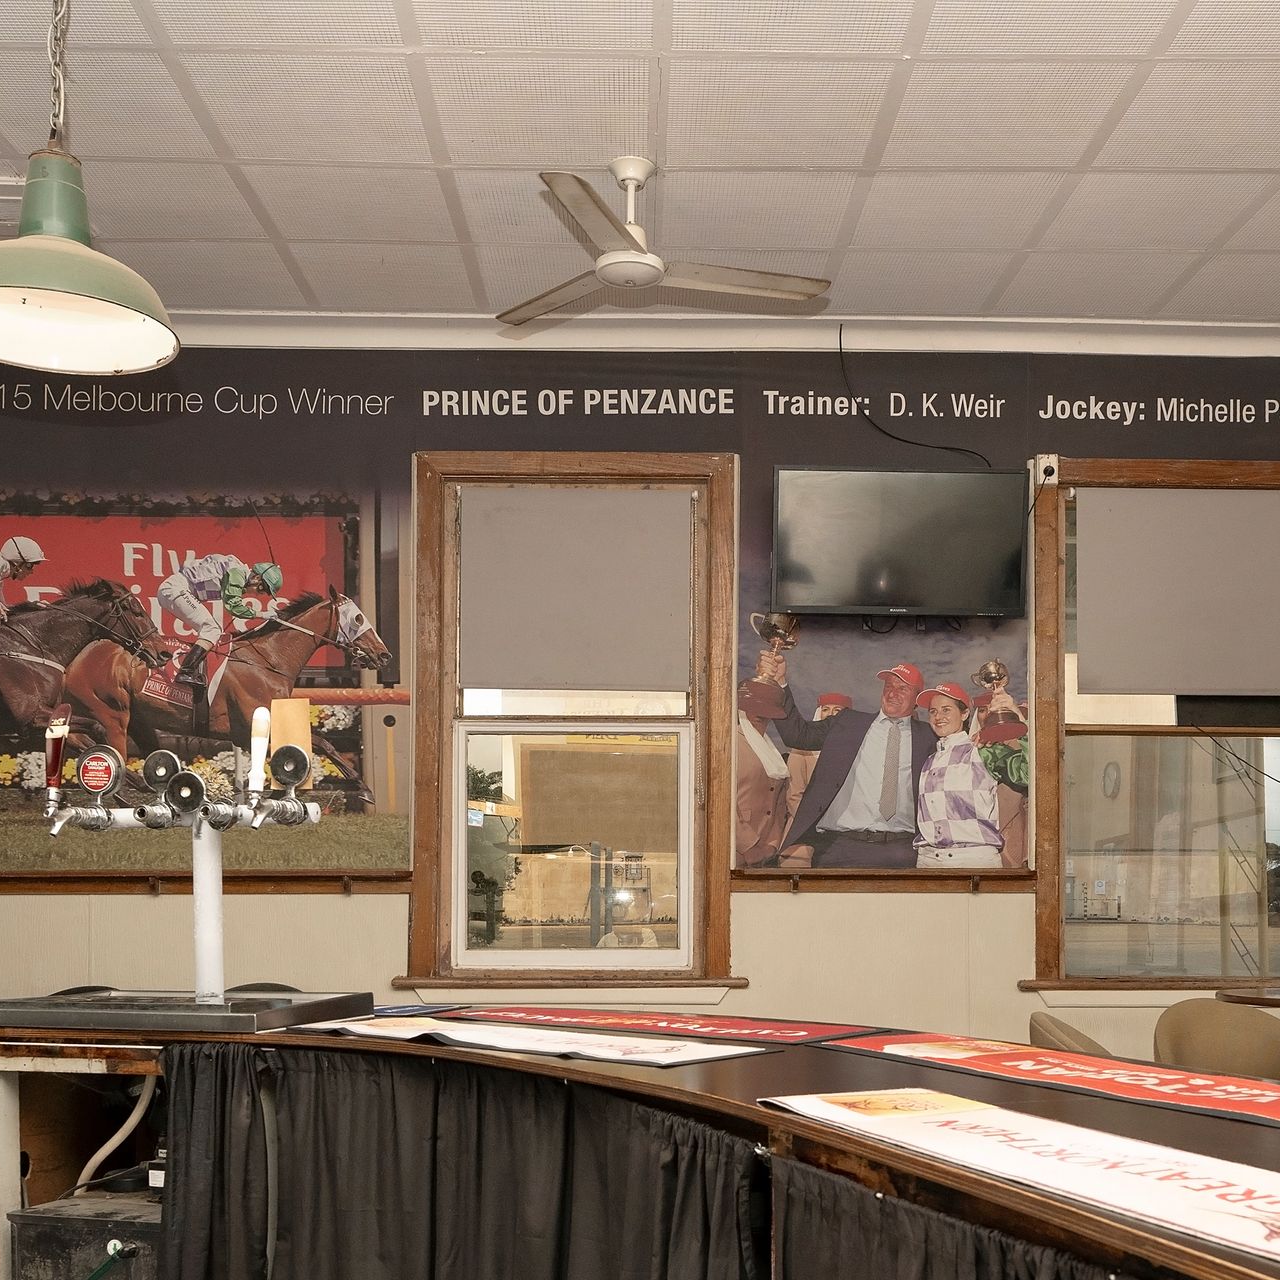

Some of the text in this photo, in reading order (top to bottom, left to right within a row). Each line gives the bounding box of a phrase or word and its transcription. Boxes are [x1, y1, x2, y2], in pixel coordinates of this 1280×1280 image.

[44, 383, 203, 413] Melbourne
[214, 386, 278, 420] Cup
[287, 387, 395, 415] Winner
[422, 388, 735, 417] PRINCE OF PENZANCE
[763, 390, 1006, 418] Trainer: D. K. Weir
[1038, 395, 1146, 425] Jockey:
[1156, 398, 1256, 423] Michelle
[146, 680, 167, 695] PRINCE
[1002, 1060, 1280, 1103] VICTORIAN
[923, 1119, 1138, 1170] NORTHERN
